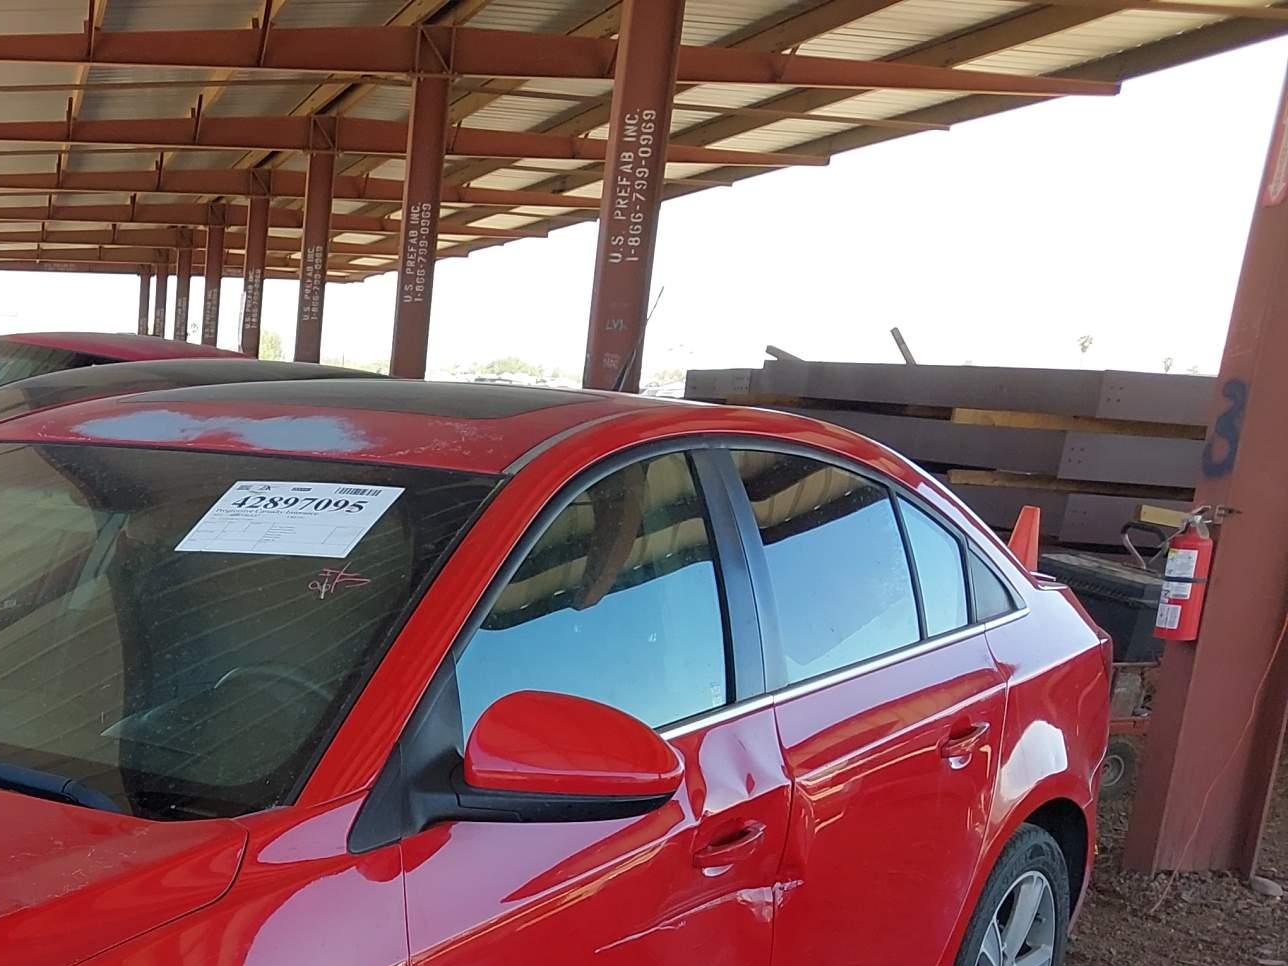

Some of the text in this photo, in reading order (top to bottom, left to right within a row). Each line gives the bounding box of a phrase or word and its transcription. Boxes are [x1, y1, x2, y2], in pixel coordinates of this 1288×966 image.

[623, 108, 640, 142] INC.
[614, 151, 634, 220] PREFAB
[625, 110, 656, 261] 1-866-799-0969
[406, 230, 418, 274] PREFAB
[232, 495, 368, 513] 42897095
